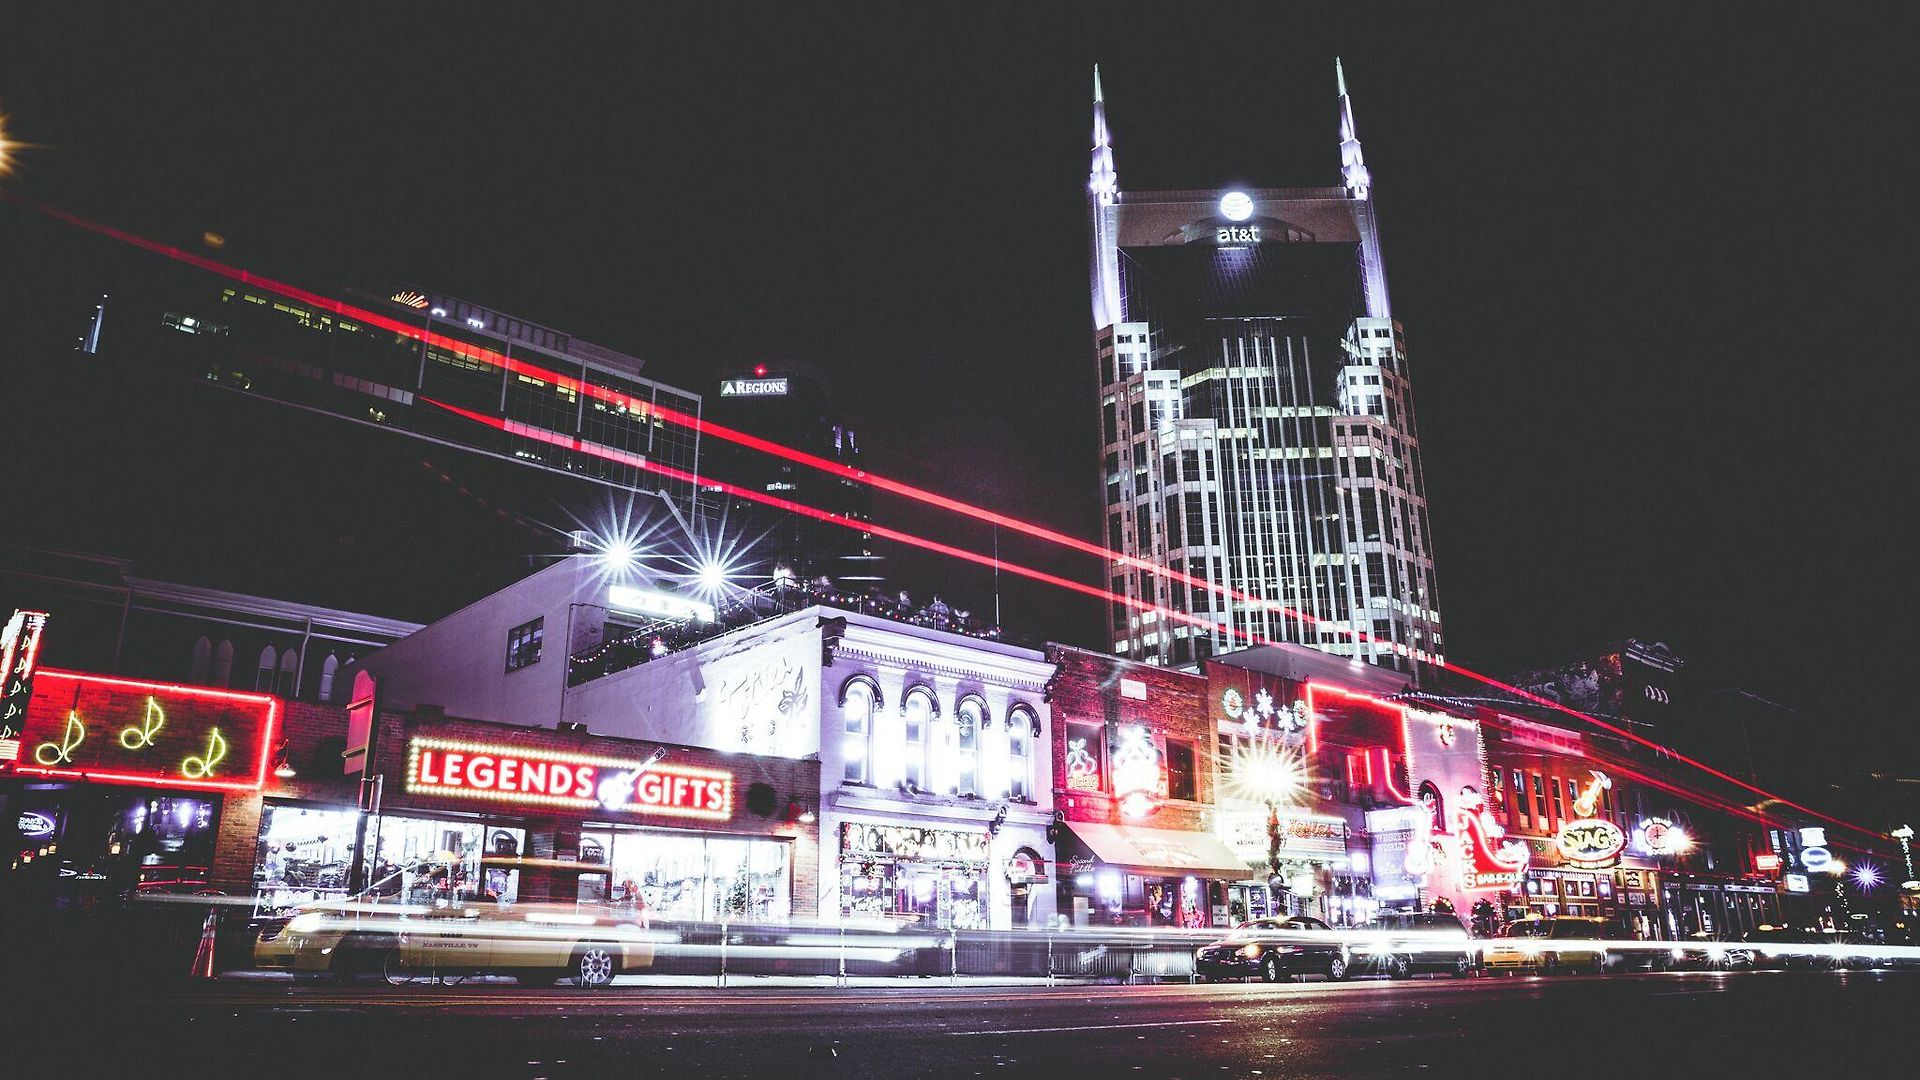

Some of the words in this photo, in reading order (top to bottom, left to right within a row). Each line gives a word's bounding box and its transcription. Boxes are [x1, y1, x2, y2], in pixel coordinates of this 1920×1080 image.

[1217, 226, 1261, 243] at&t
[736, 381, 786, 394] REGIONS
[419, 751, 594, 798] LEGENDS
[637, 774, 724, 811] GIFTS
[1069, 855, 1096, 865] Second
